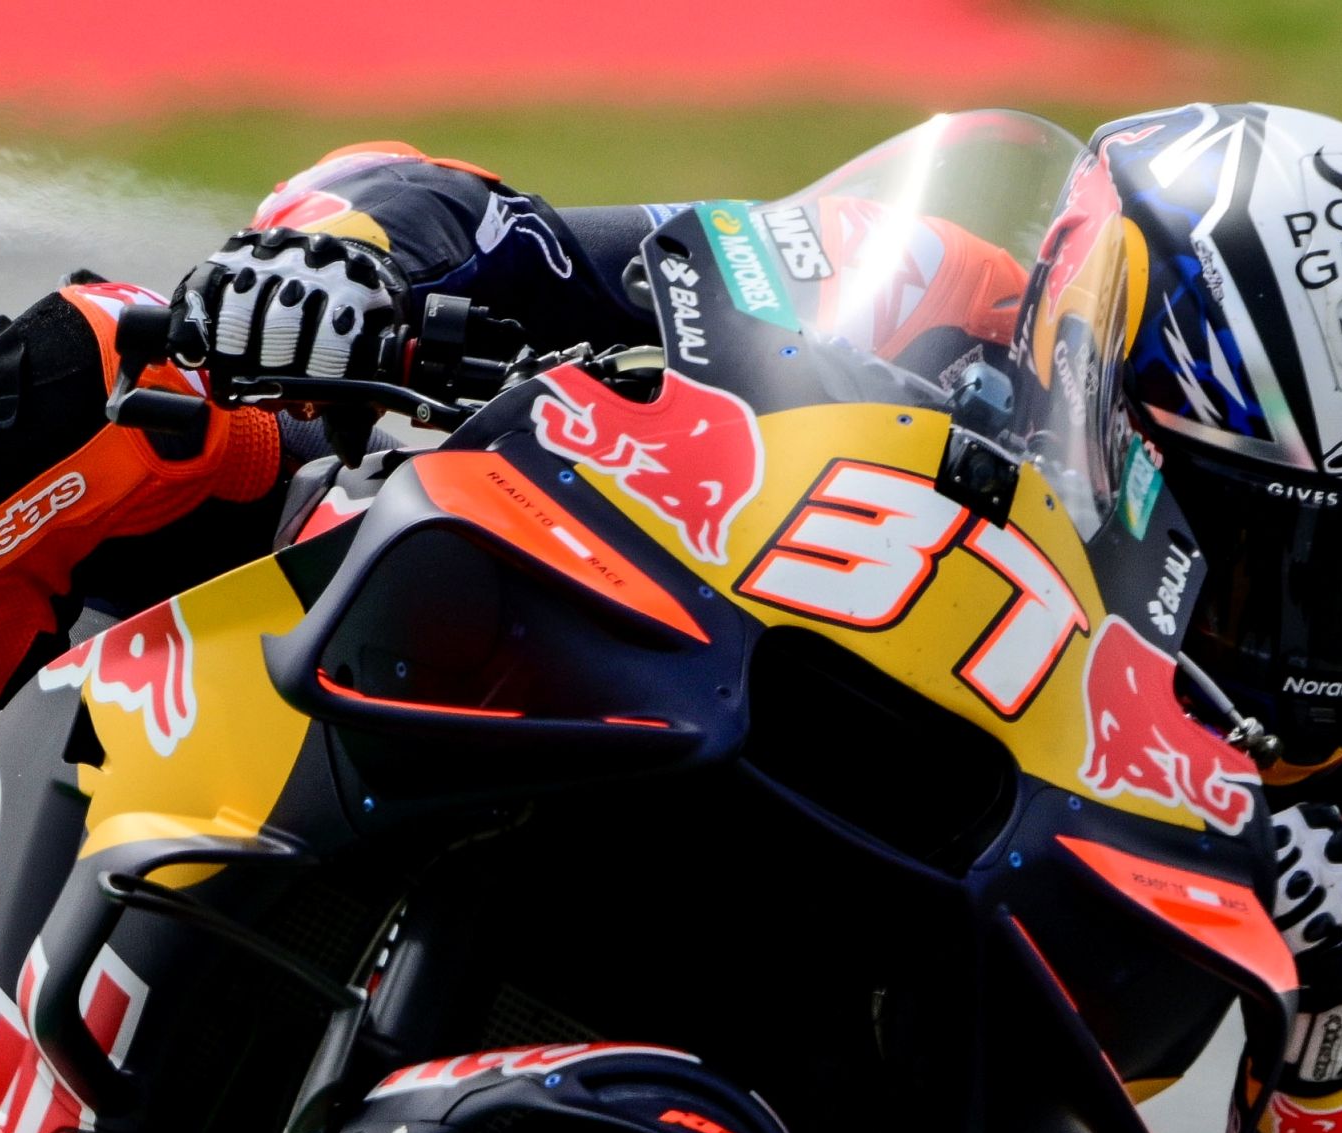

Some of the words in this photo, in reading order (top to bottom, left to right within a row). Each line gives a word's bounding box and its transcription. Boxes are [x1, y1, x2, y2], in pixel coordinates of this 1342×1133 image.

[717, 234, 781, 311] MOTOREX
[761, 206, 834, 281] WRS
[669, 285, 710, 365] BAJAJ
[487, 471, 535, 510] READY
[535, 511, 554, 527] TO
[588, 557, 626, 588] RACE
[1267, 482, 1339, 506] GIVES
[733, 458, 1091, 722] 37
